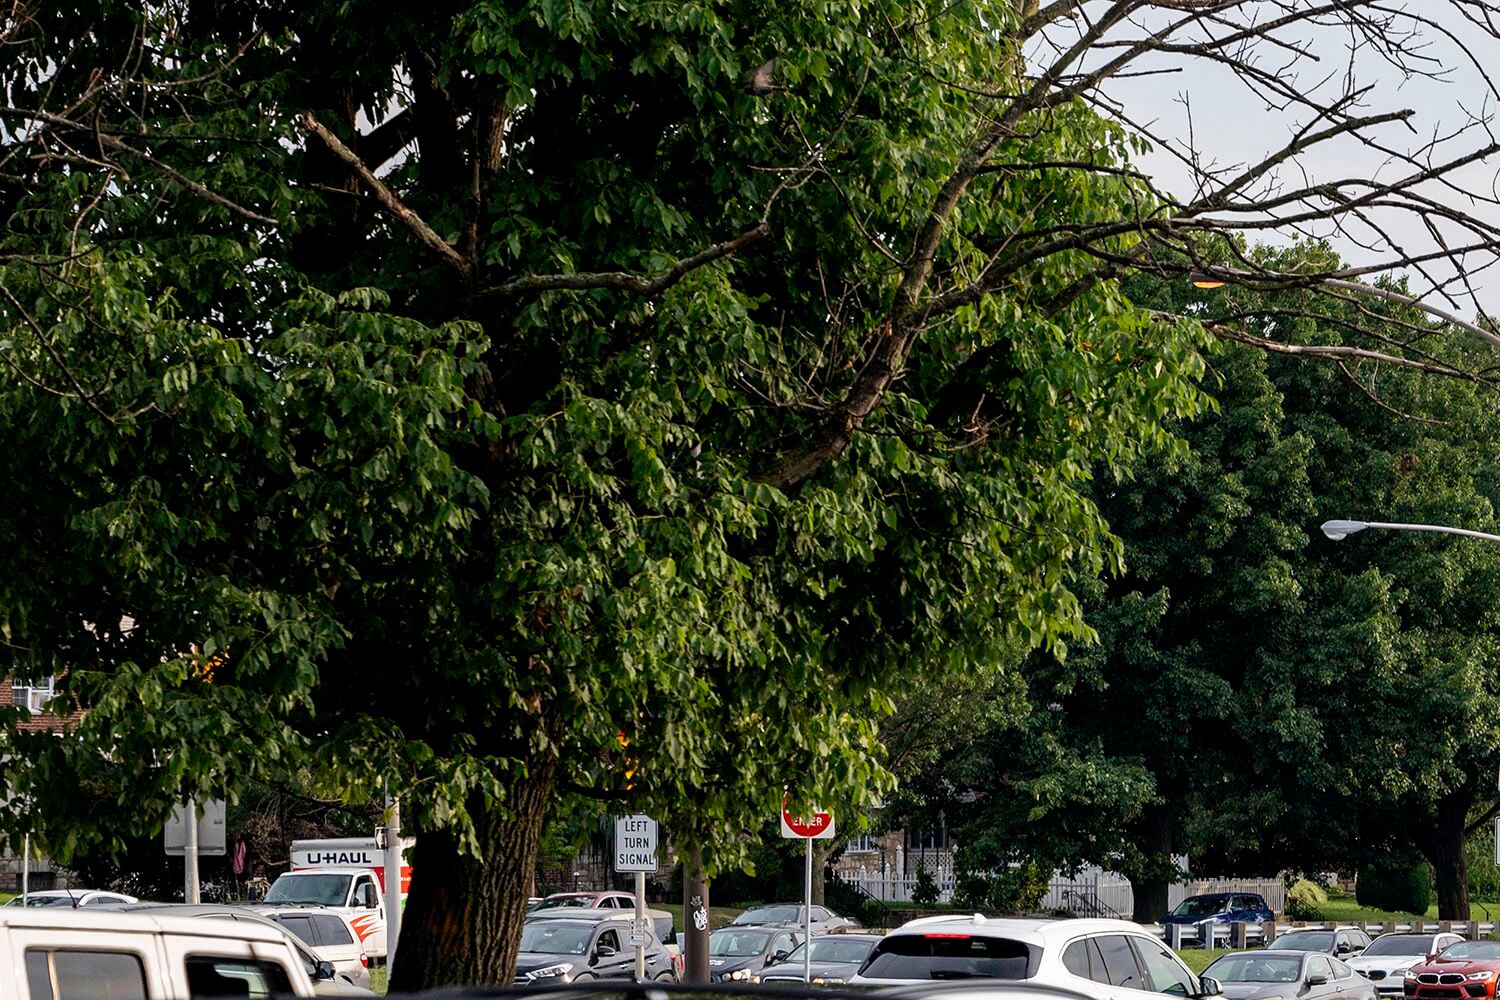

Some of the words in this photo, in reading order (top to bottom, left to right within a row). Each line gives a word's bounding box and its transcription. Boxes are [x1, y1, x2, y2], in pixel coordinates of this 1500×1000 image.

[625, 821, 648, 832] LEFT
[624, 838, 649, 848] TURN
[307, 852, 371, 864] U-HAUL
[619, 853, 654, 865] SIGNAL
